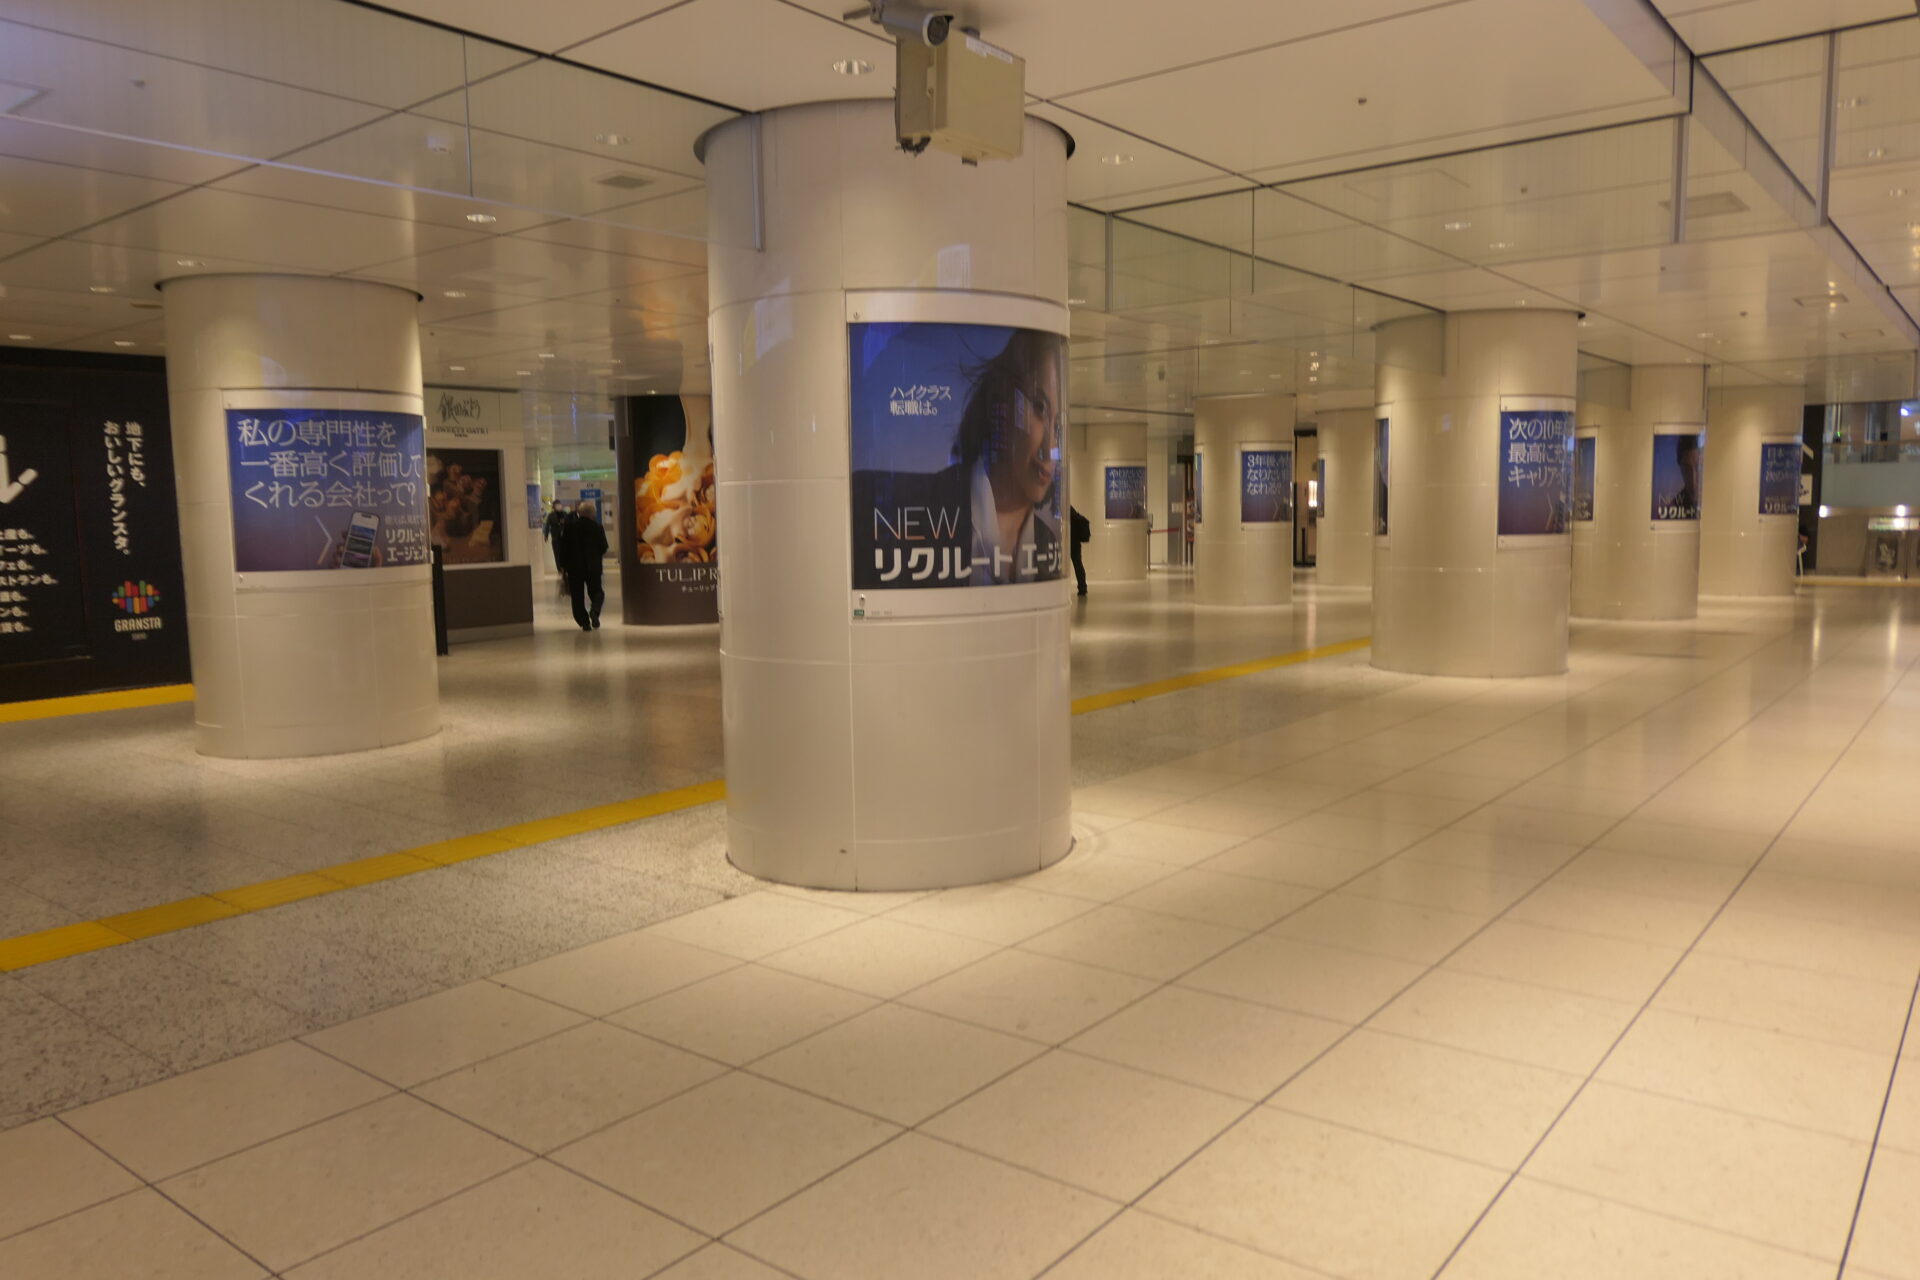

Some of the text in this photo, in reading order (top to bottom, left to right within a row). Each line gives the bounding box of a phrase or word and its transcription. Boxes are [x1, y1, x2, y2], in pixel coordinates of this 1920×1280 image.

[889, 384, 951, 400] ハイクラス
[237, 418, 397, 448] 私の専門性を
[240, 450, 422, 479] 一番高く評価して
[104, 420, 131, 555] おいしいグランスタ。
[244, 481, 417, 509] くれる会社って?
[385, 528, 425, 544] リクルート
[873, 506, 961, 541] NEW
[655, 567, 707, 582] TULIP
[874, 546, 1013, 582] リクルート
[114, 616, 162, 632] GRANSTA
